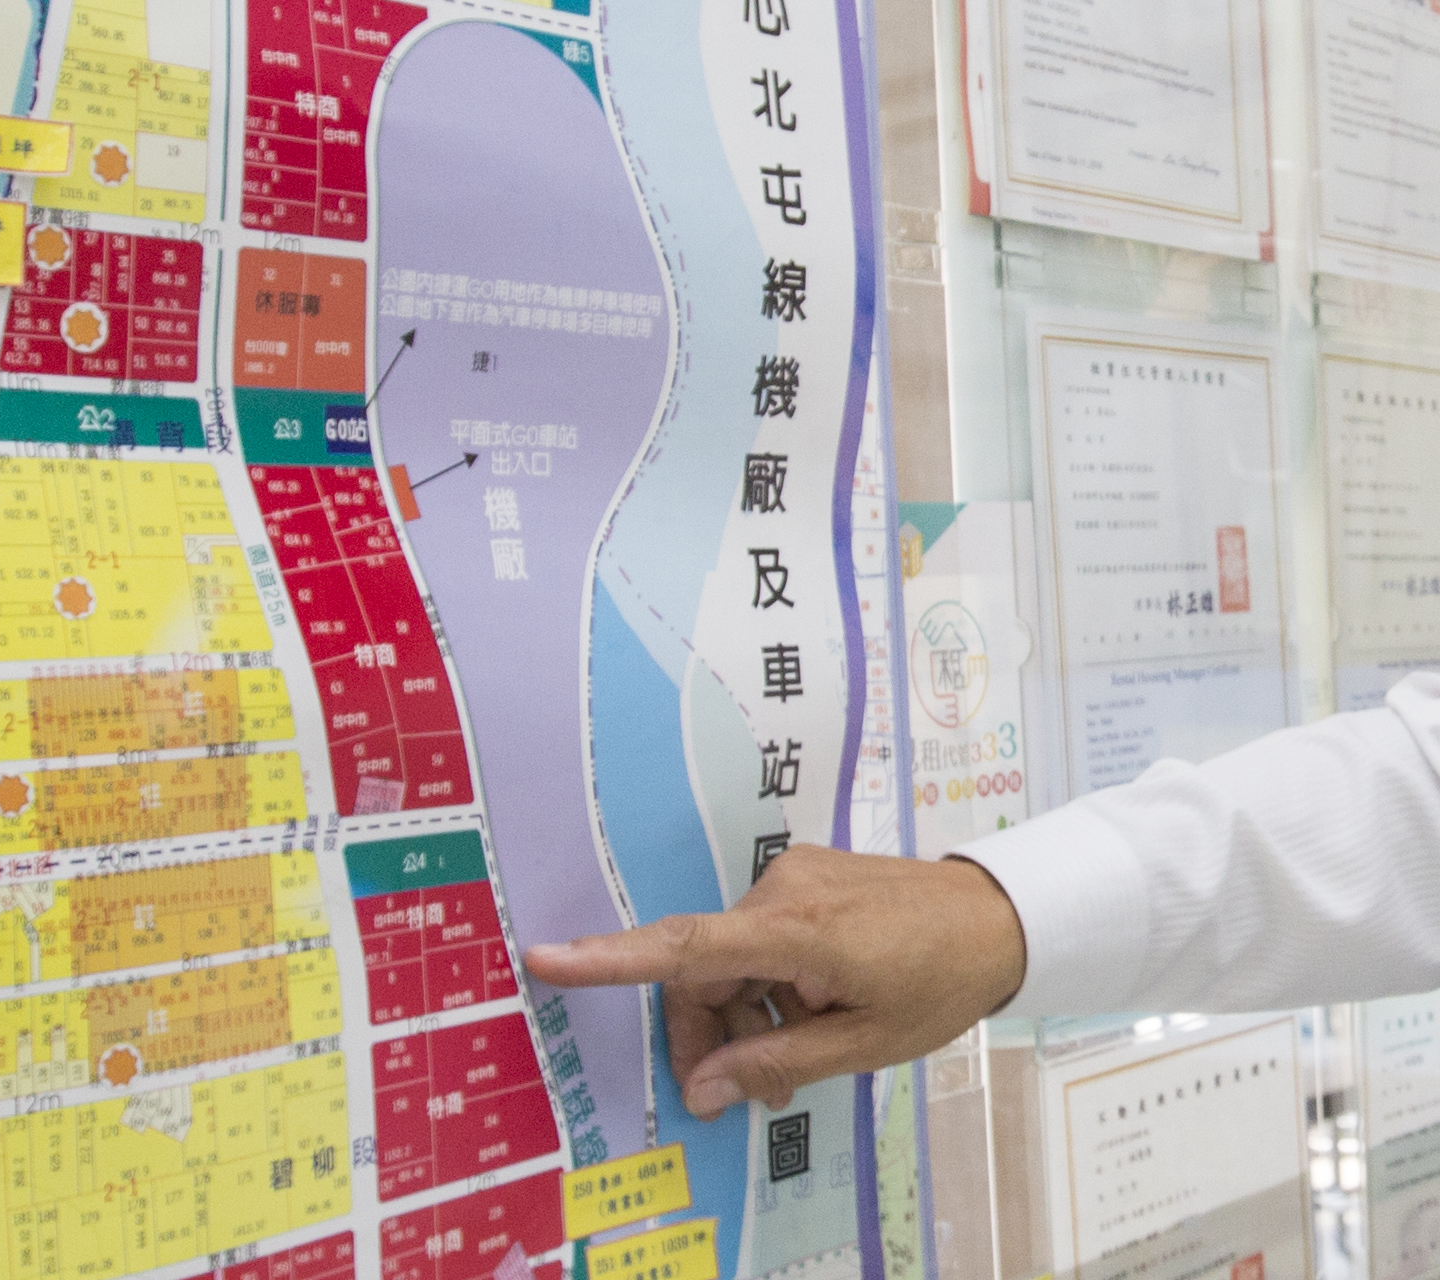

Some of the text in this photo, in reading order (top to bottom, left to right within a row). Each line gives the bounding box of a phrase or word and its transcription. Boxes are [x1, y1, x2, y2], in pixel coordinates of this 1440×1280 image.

[77, 405, 116, 431] 公2
[274, 417, 302, 439] 公3
[491, 451, 551, 477] 出入口
[353, 643, 396, 668] 特商
[427, 1092, 464, 1118] 特商
